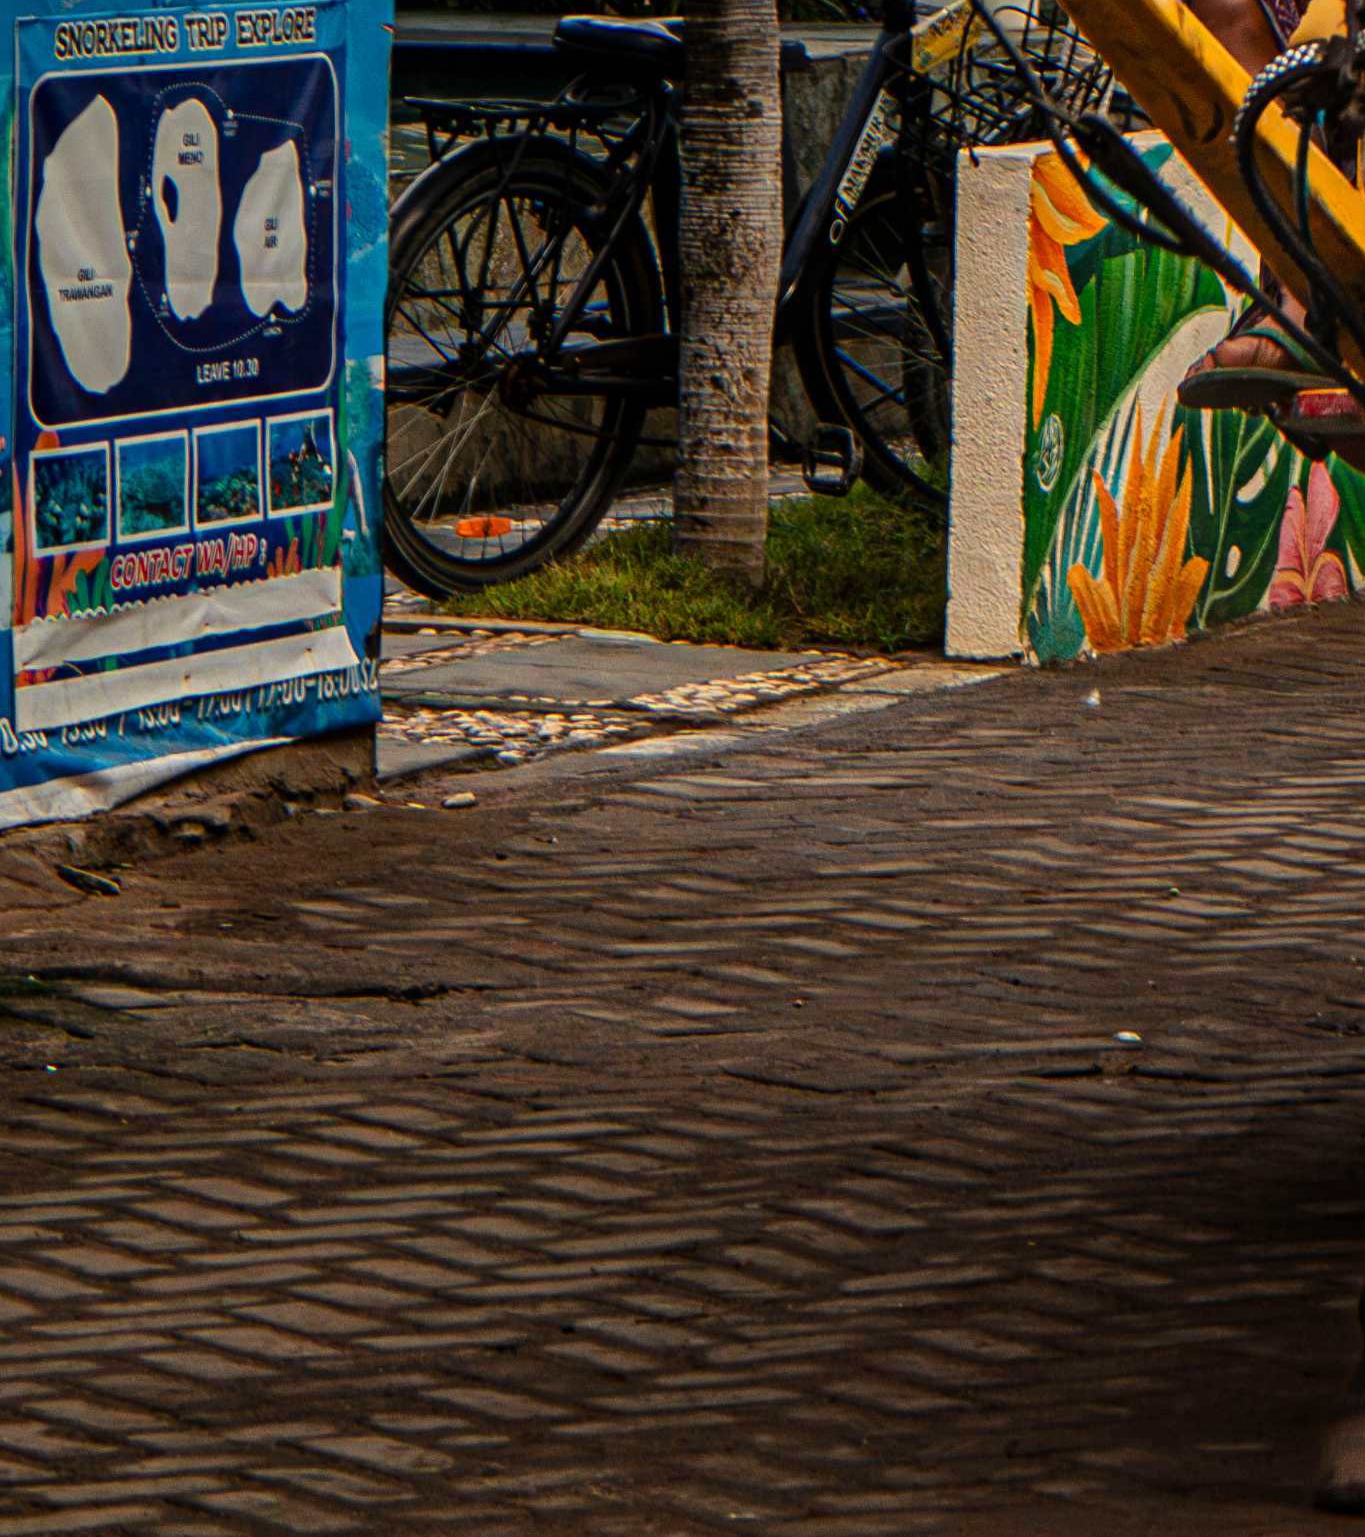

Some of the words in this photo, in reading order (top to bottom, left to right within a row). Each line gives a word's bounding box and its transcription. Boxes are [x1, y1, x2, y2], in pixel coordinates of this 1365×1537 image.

[55, 15, 179, 60] SNORKELING
[184, 11, 229, 51] TRIP
[236, 8, 317, 47] EXPLORE
[196, 361, 231, 384] LEAVE
[233, 357, 260, 380] 10.30
[110, 542, 195, 591] CONTACT
[196, 532, 258, 579] WA/HP
